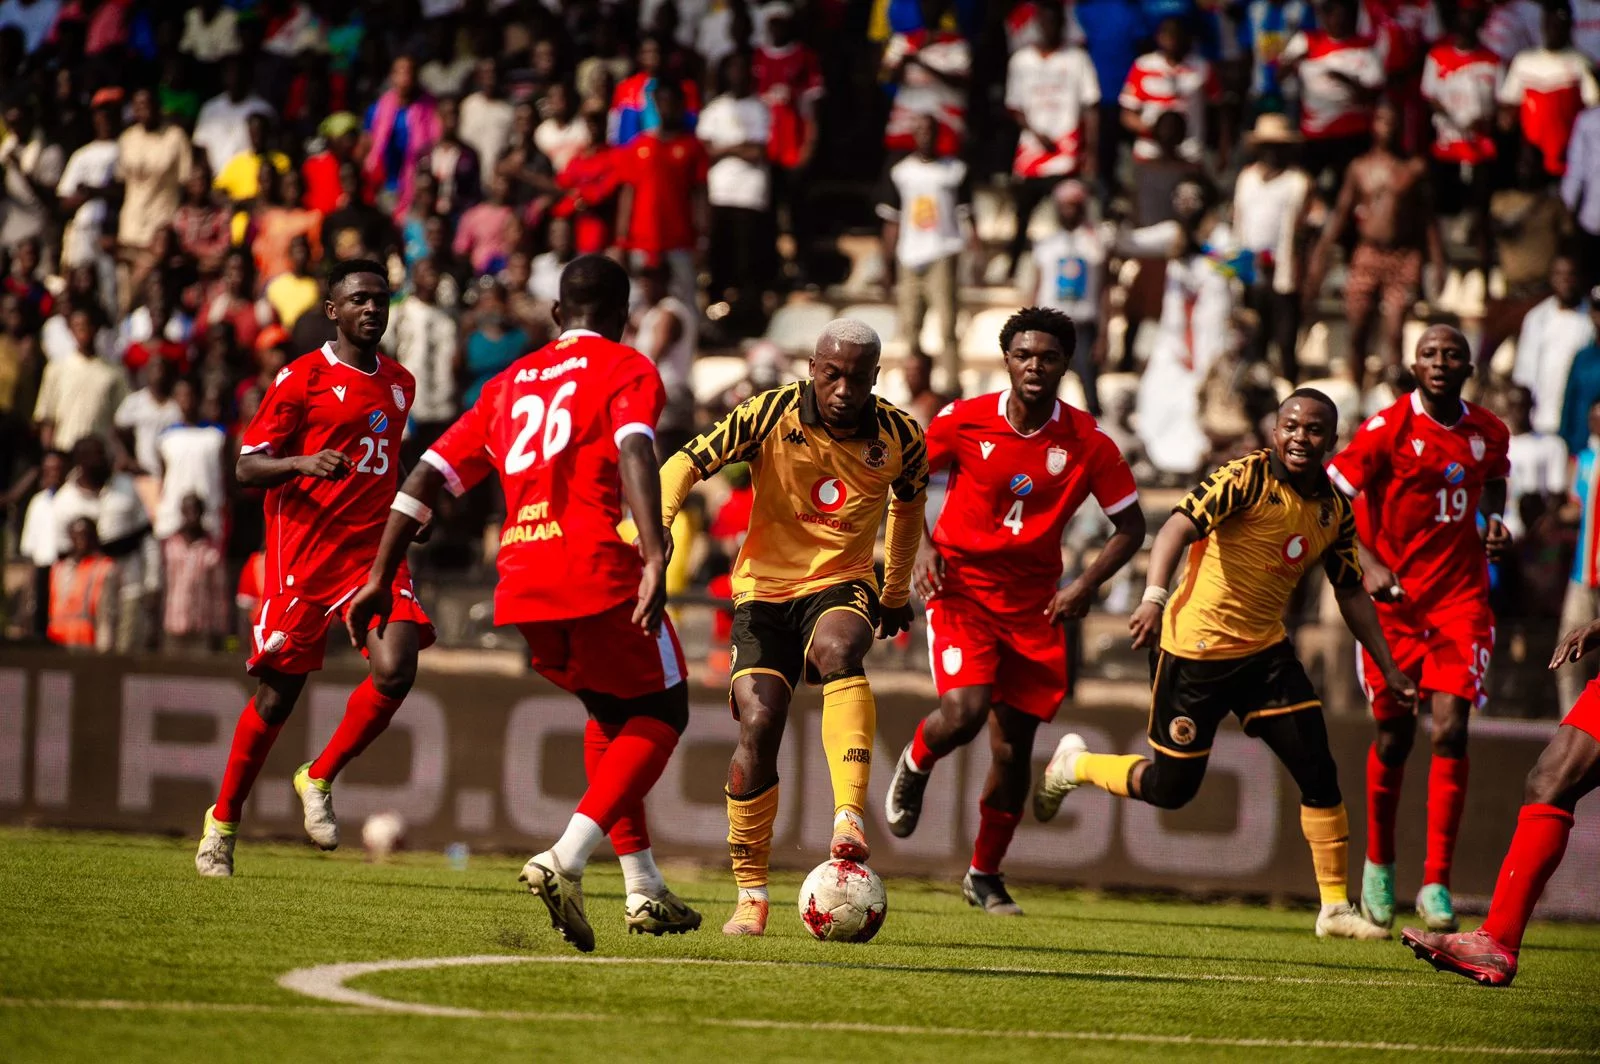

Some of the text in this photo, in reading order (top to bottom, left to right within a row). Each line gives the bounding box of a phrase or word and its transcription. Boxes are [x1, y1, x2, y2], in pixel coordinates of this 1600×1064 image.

[514, 356, 588, 384] AS SIMBA
[504, 380, 577, 475] 26
[356, 436, 389, 475] 25
[794, 511, 853, 531] vodacom
[1003, 499, 1024, 536] 4
[1435, 487, 1468, 523] 19
[1468, 642, 1491, 678] 19
